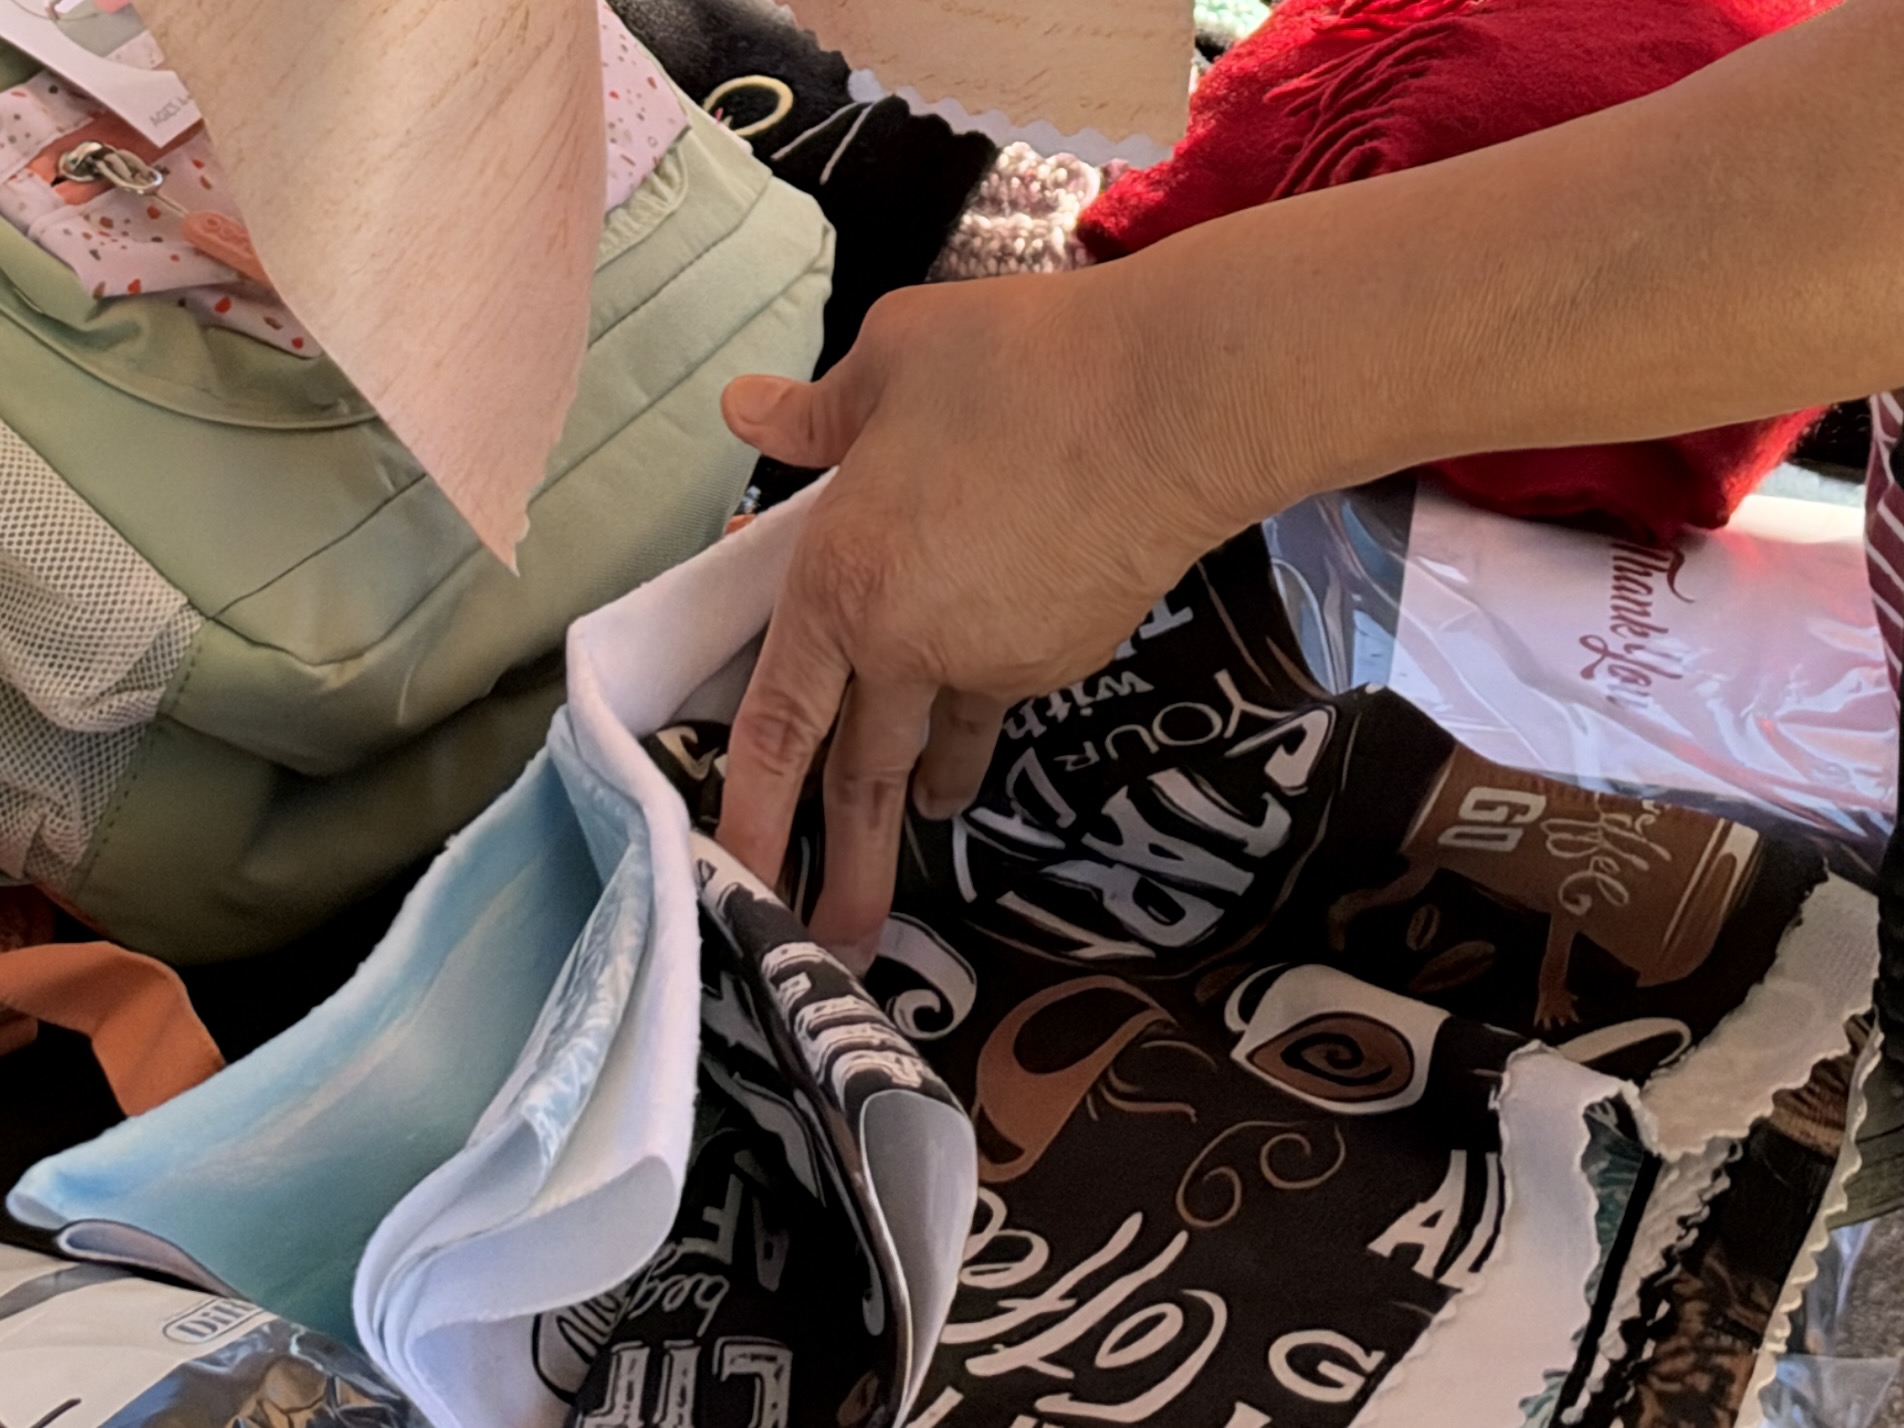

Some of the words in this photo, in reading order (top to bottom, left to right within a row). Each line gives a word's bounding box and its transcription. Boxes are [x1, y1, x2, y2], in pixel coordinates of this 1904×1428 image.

[1609, 541, 1696, 639] Thank
[1001, 669, 1156, 741] with
[1053, 668, 1298, 773] YOUR
[1437, 786, 1546, 853] GO
